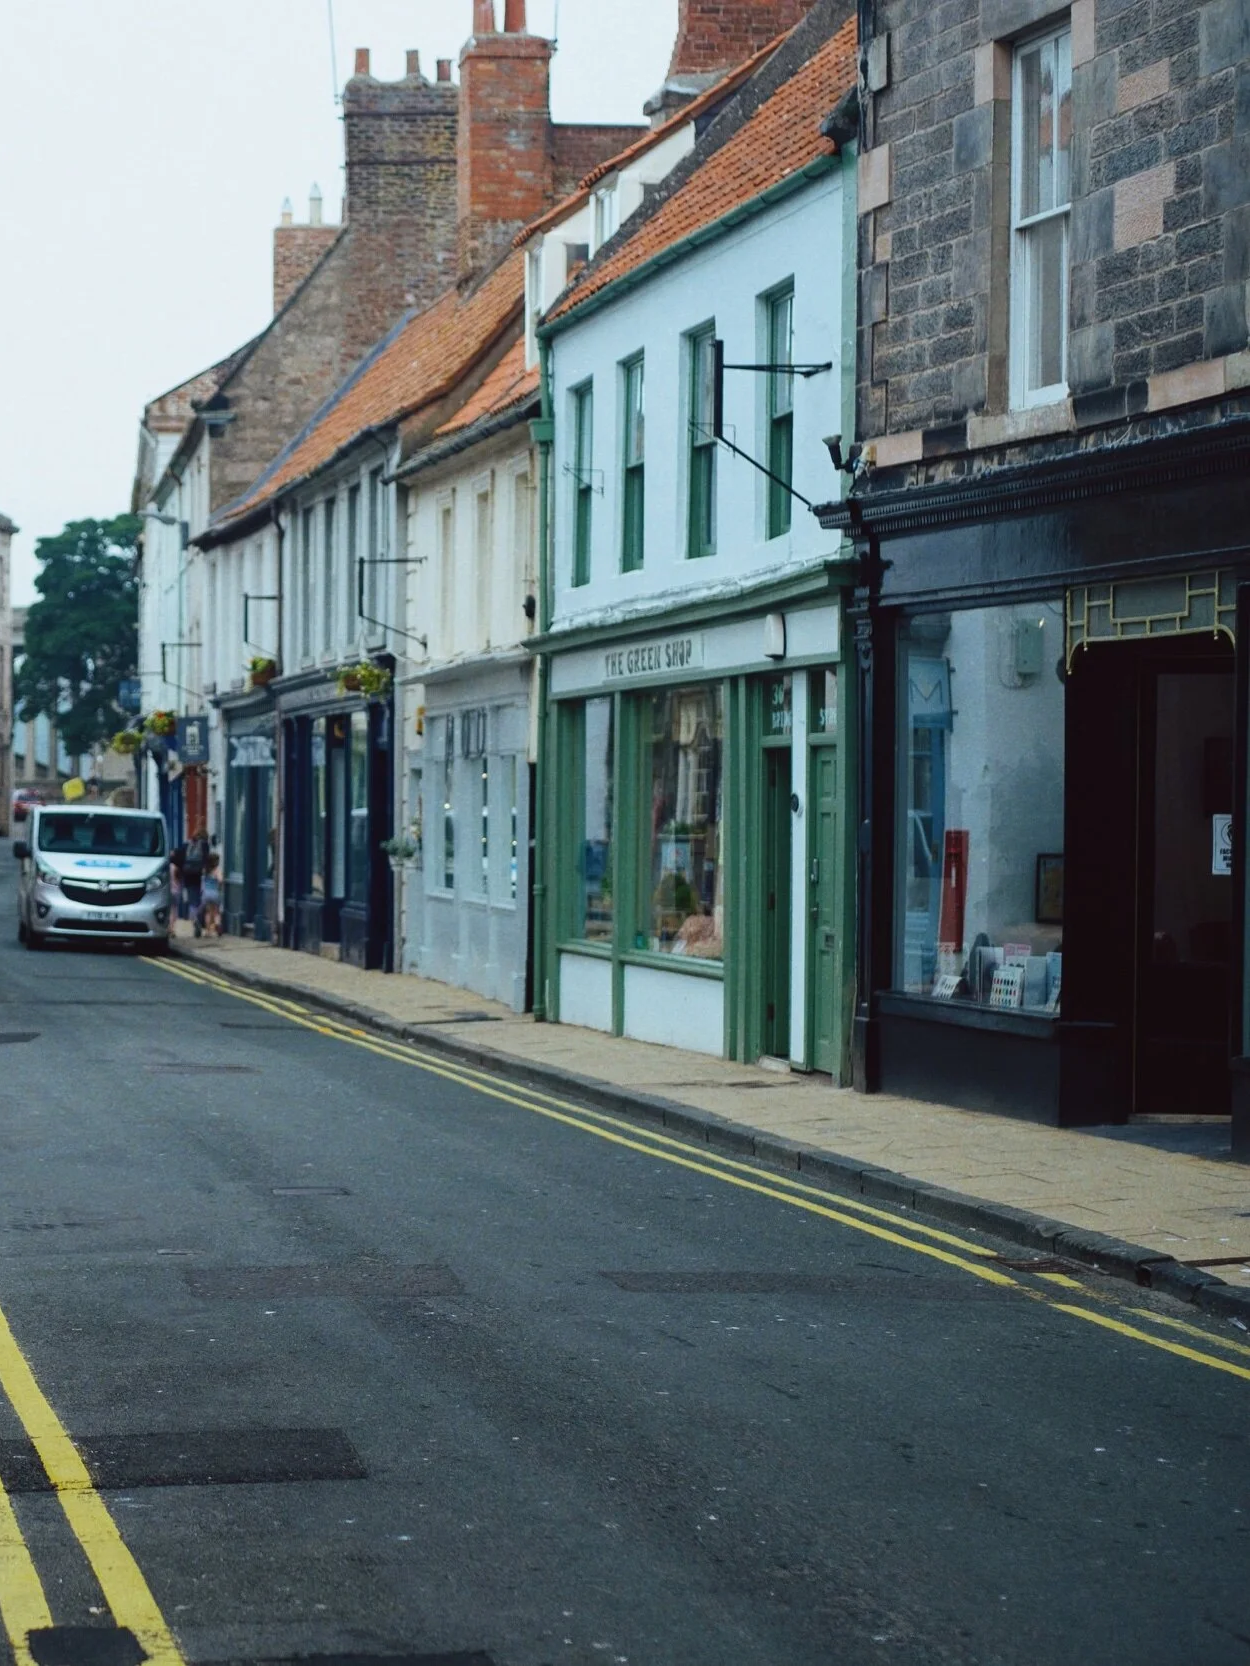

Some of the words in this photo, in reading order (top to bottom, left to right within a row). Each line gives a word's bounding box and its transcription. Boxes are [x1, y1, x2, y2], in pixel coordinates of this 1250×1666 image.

[605, 651, 623, 677] THE
[626, 645, 661, 674] GREEN
[665, 638, 692, 668] SHOP
